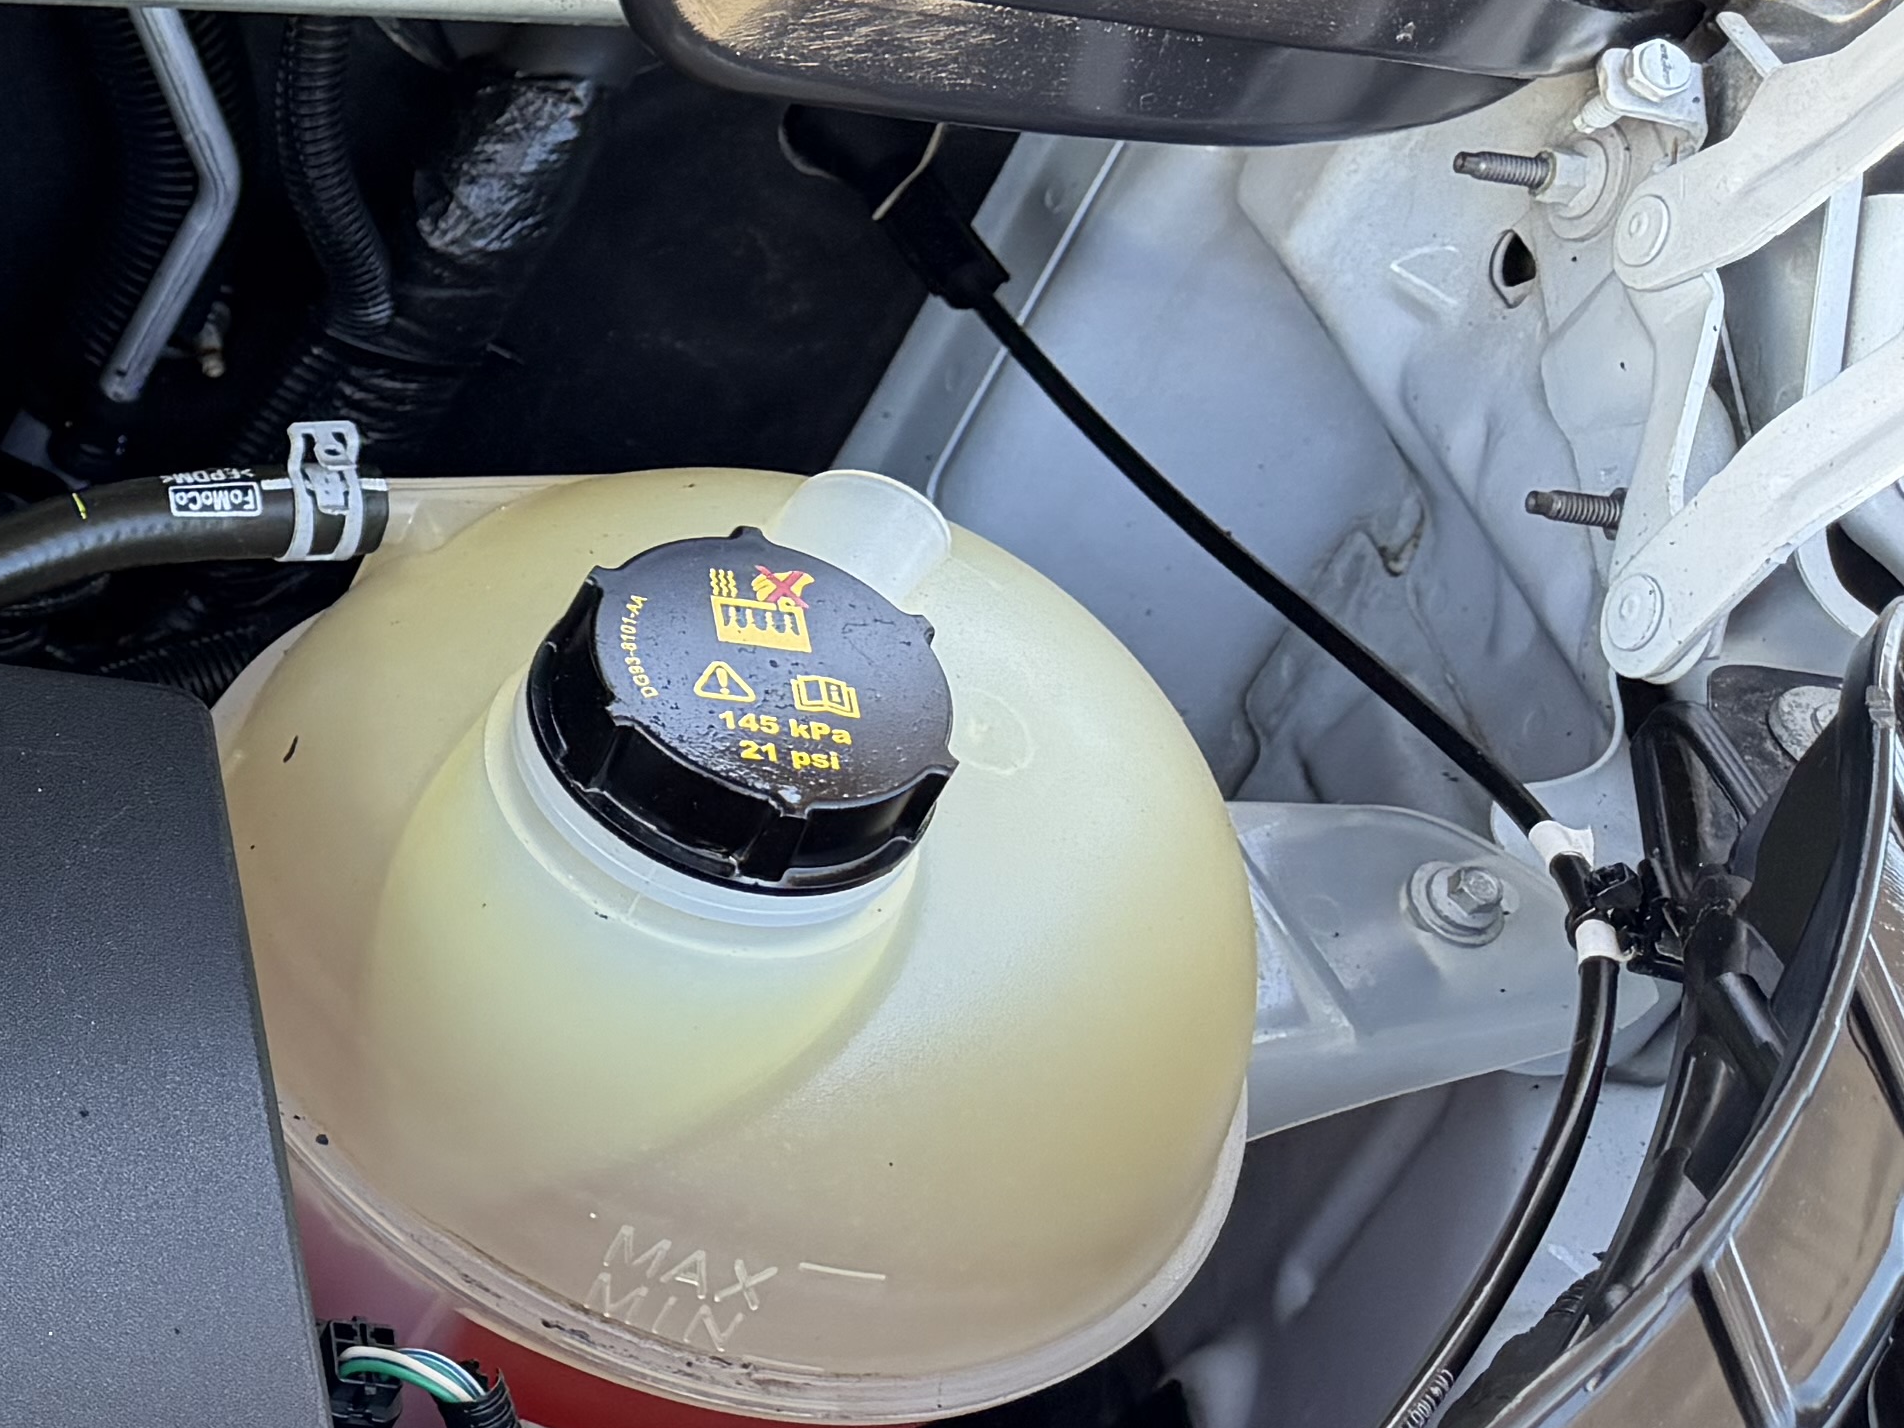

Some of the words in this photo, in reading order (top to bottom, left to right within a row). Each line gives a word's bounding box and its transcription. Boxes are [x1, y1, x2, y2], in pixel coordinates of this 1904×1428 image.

[174, 487, 258, 512] FoMoCo
[718, 710, 779, 735] 145
[787, 718, 853, 746] kPa
[738, 739, 778, 762] 21
[790, 749, 841, 772] psi
[602, 1223, 780, 1311] MAX
[583, 1271, 747, 1352] MIN
